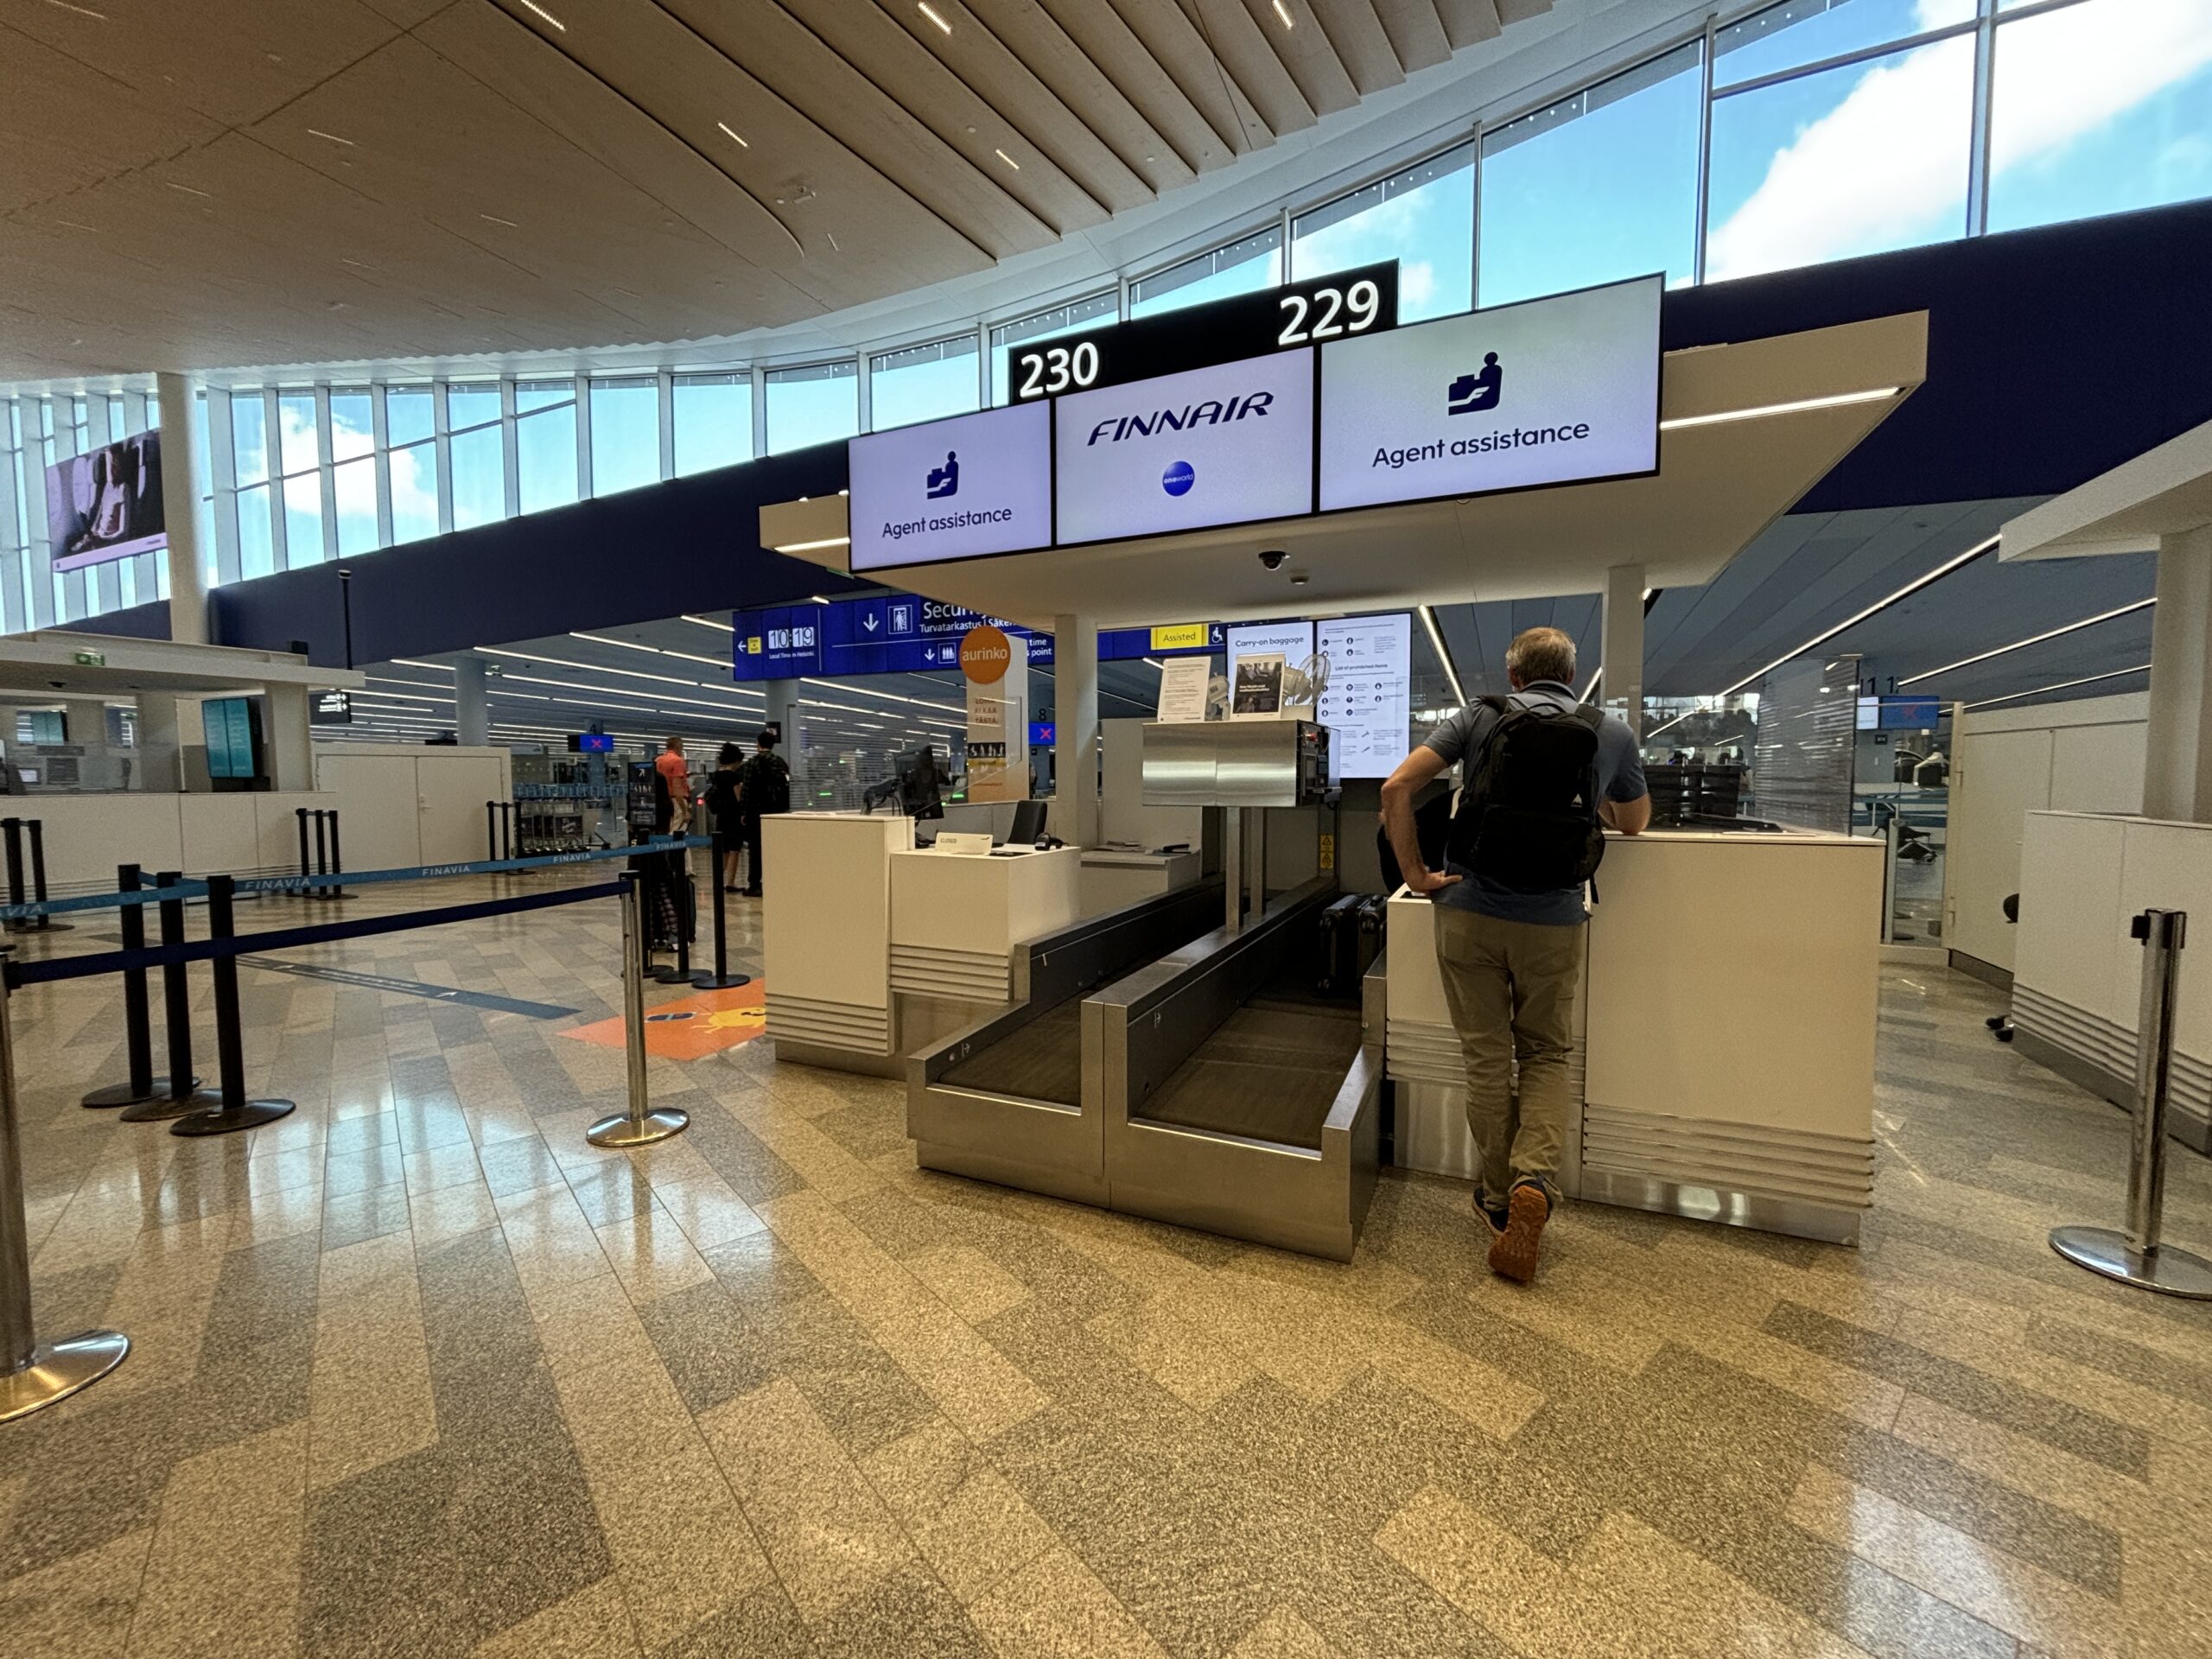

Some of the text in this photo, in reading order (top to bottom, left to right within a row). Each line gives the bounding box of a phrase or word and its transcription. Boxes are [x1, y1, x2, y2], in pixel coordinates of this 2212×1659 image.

[1277, 280, 1380, 346] 229
[1019, 341, 1100, 398] 230
[1087, 391, 1274, 446] FINNAIR
[1372, 423, 1590, 469] Agent assistance
[1163, 474, 1194, 484] oneworld
[882, 508, 1013, 539] Agent assistance
[919, 620, 982, 633] Turvatarkastus
[768, 627, 815, 650] 10:19
[1029, 638, 1047, 646] time
[1163, 632, 1196, 643] Assisted
[1236, 636, 1304, 647] Carry-on baggage
[962, 647, 1008, 662] aurinko
[1031, 648, 1052, 658] point
[1039, 709, 1046, 721] 8
[656, 841, 687, 851] FINAVIA
[553, 853, 591, 863] FINAVIA
[422, 864, 471, 876] FINAVIA
[245, 877, 311, 891] FINAVIA
